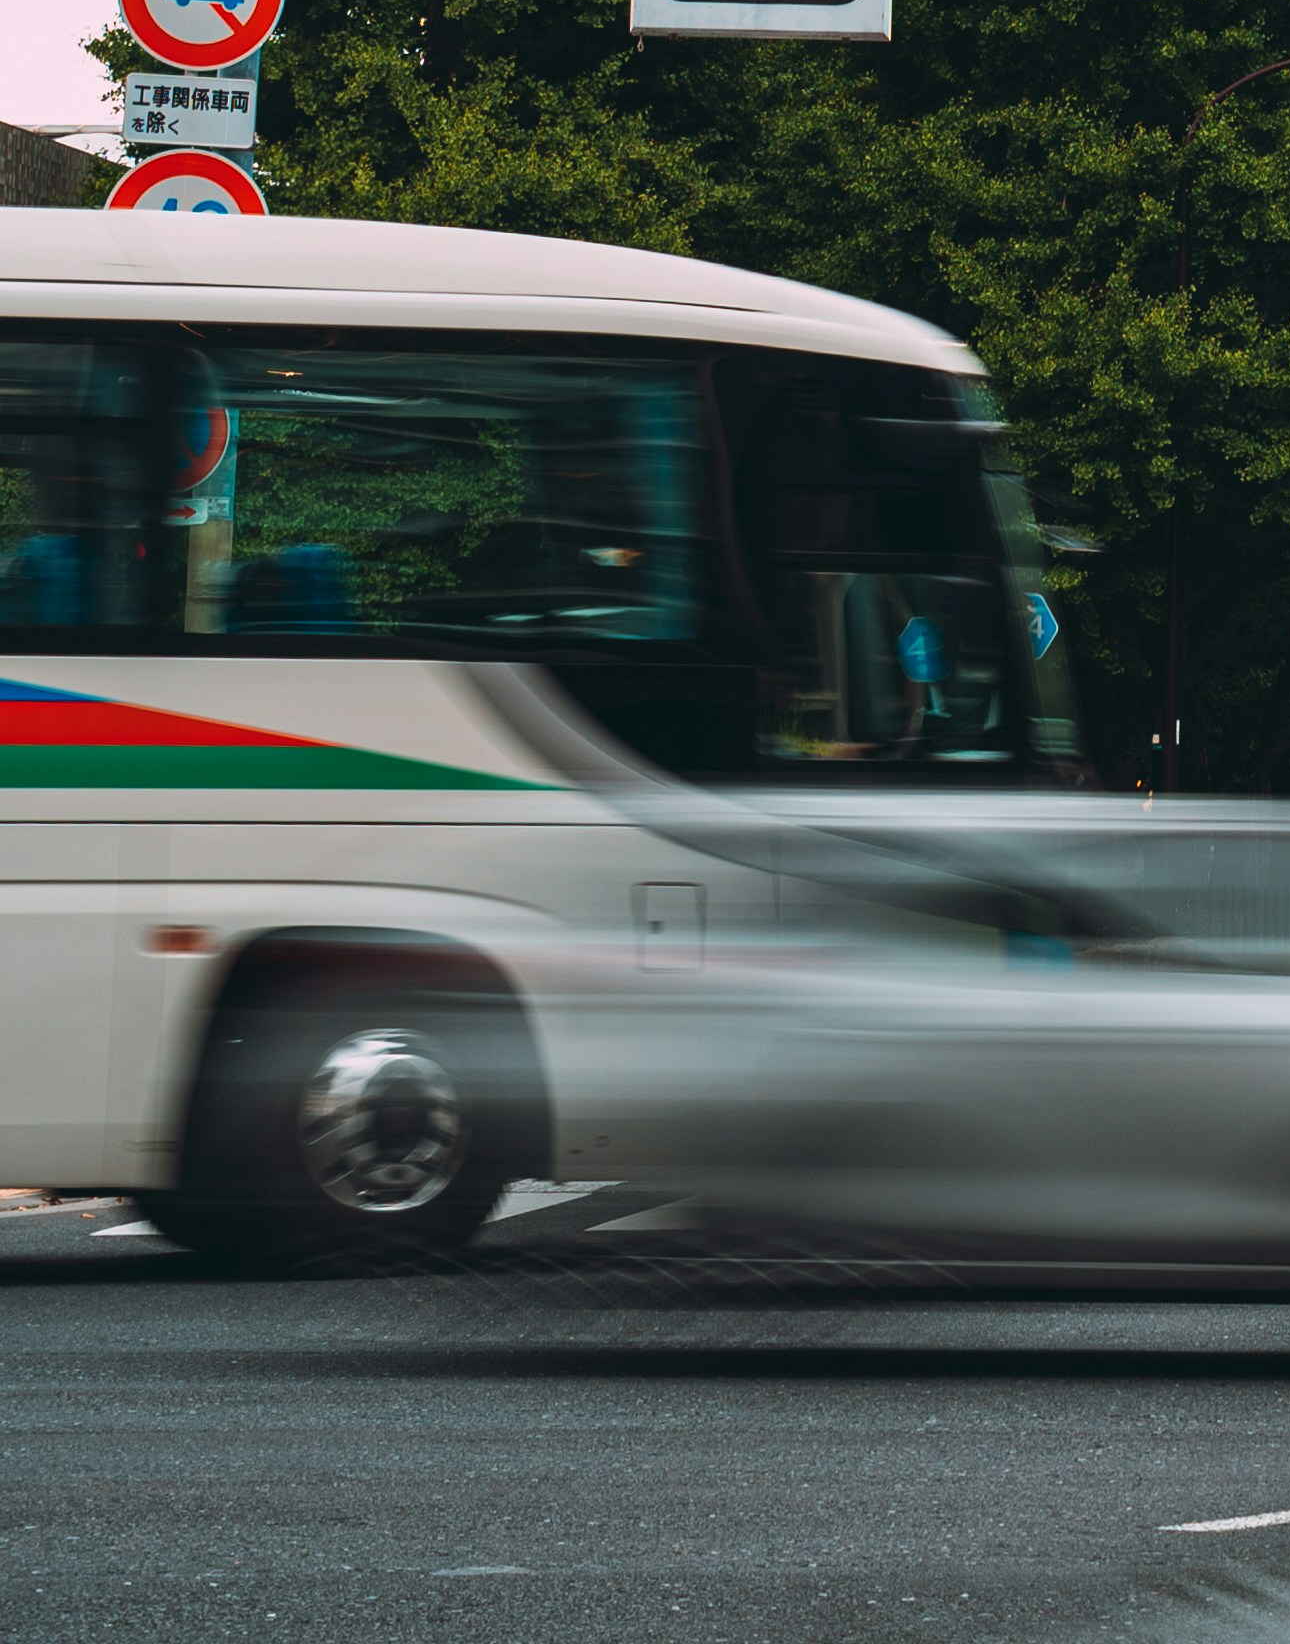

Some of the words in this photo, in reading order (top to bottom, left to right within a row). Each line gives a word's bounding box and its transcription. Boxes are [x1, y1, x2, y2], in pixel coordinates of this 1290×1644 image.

[132, 84, 250, 114] 工事関係車両
[131, 111, 180, 135] を除く
